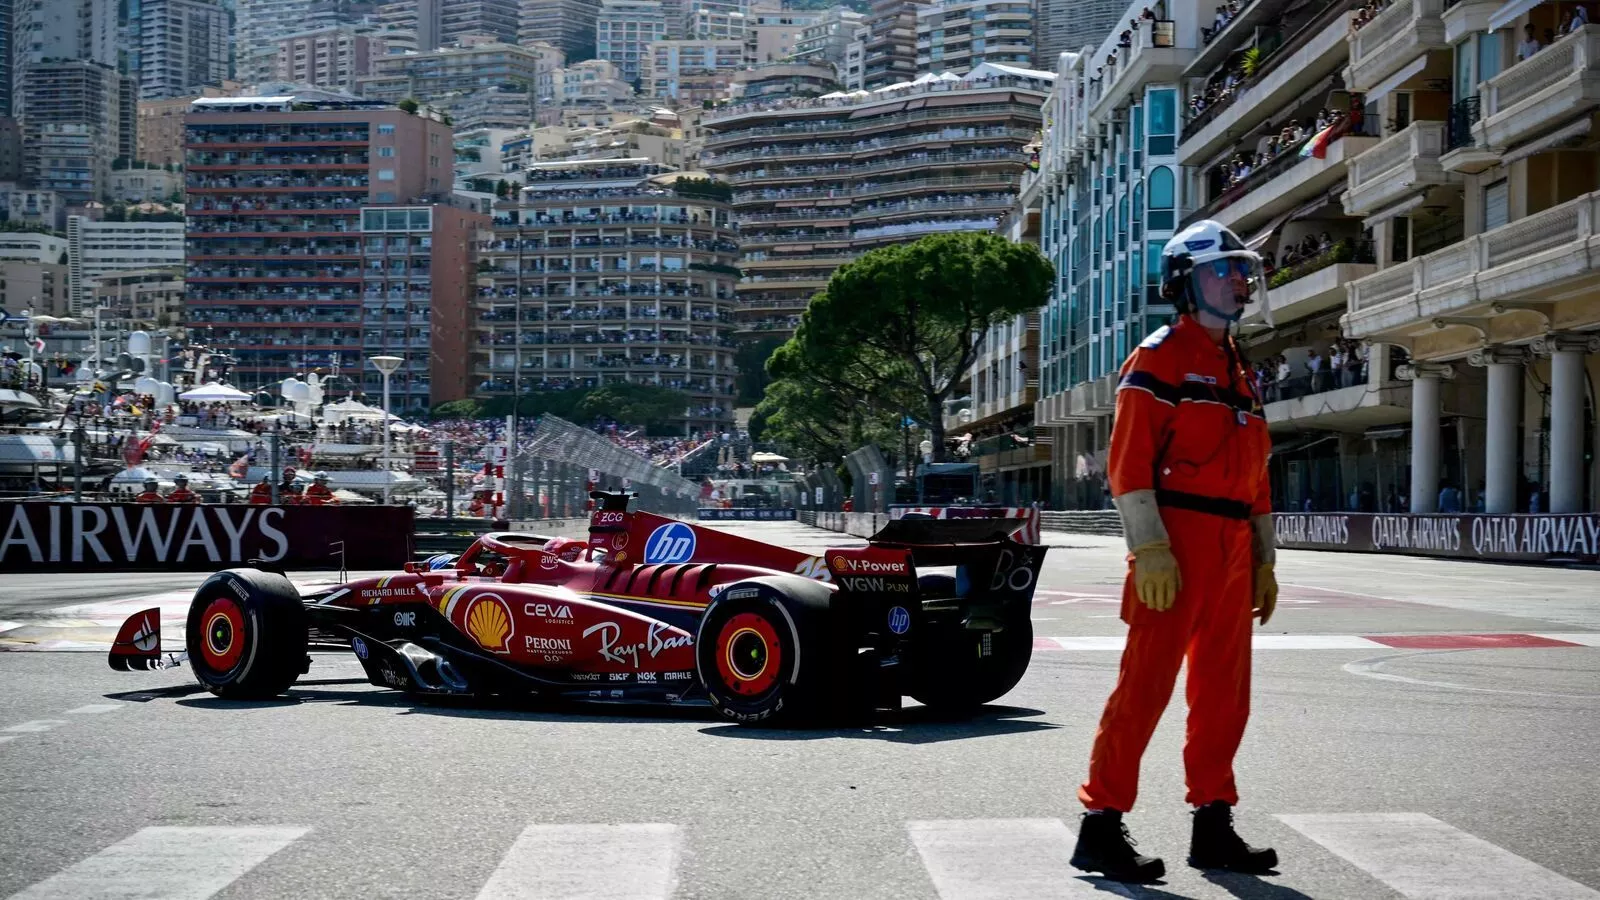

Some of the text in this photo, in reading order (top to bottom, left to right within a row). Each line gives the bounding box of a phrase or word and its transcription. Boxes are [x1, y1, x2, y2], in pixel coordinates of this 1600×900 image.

[0, 505, 289, 563] AIRWAYS
[1276, 516, 1349, 544] QATAR AIRWAYS
[1372, 516, 1460, 551] QATAR AIRWAYS
[1472, 517, 1517, 554] QATAR
[648, 522, 692, 563] hp
[540, 555, 558, 565] aws
[847, 559, 905, 573] V-Power
[361, 587, 416, 597] RICHARD MILLE
[841, 577, 909, 593] VGW PLAY
[891, 607, 908, 634] hp
[525, 635, 572, 650] PERONI
[608, 672, 630, 681] SKF
[636, 671, 657, 681] NGK
[663, 671, 693, 681] MAHLE
